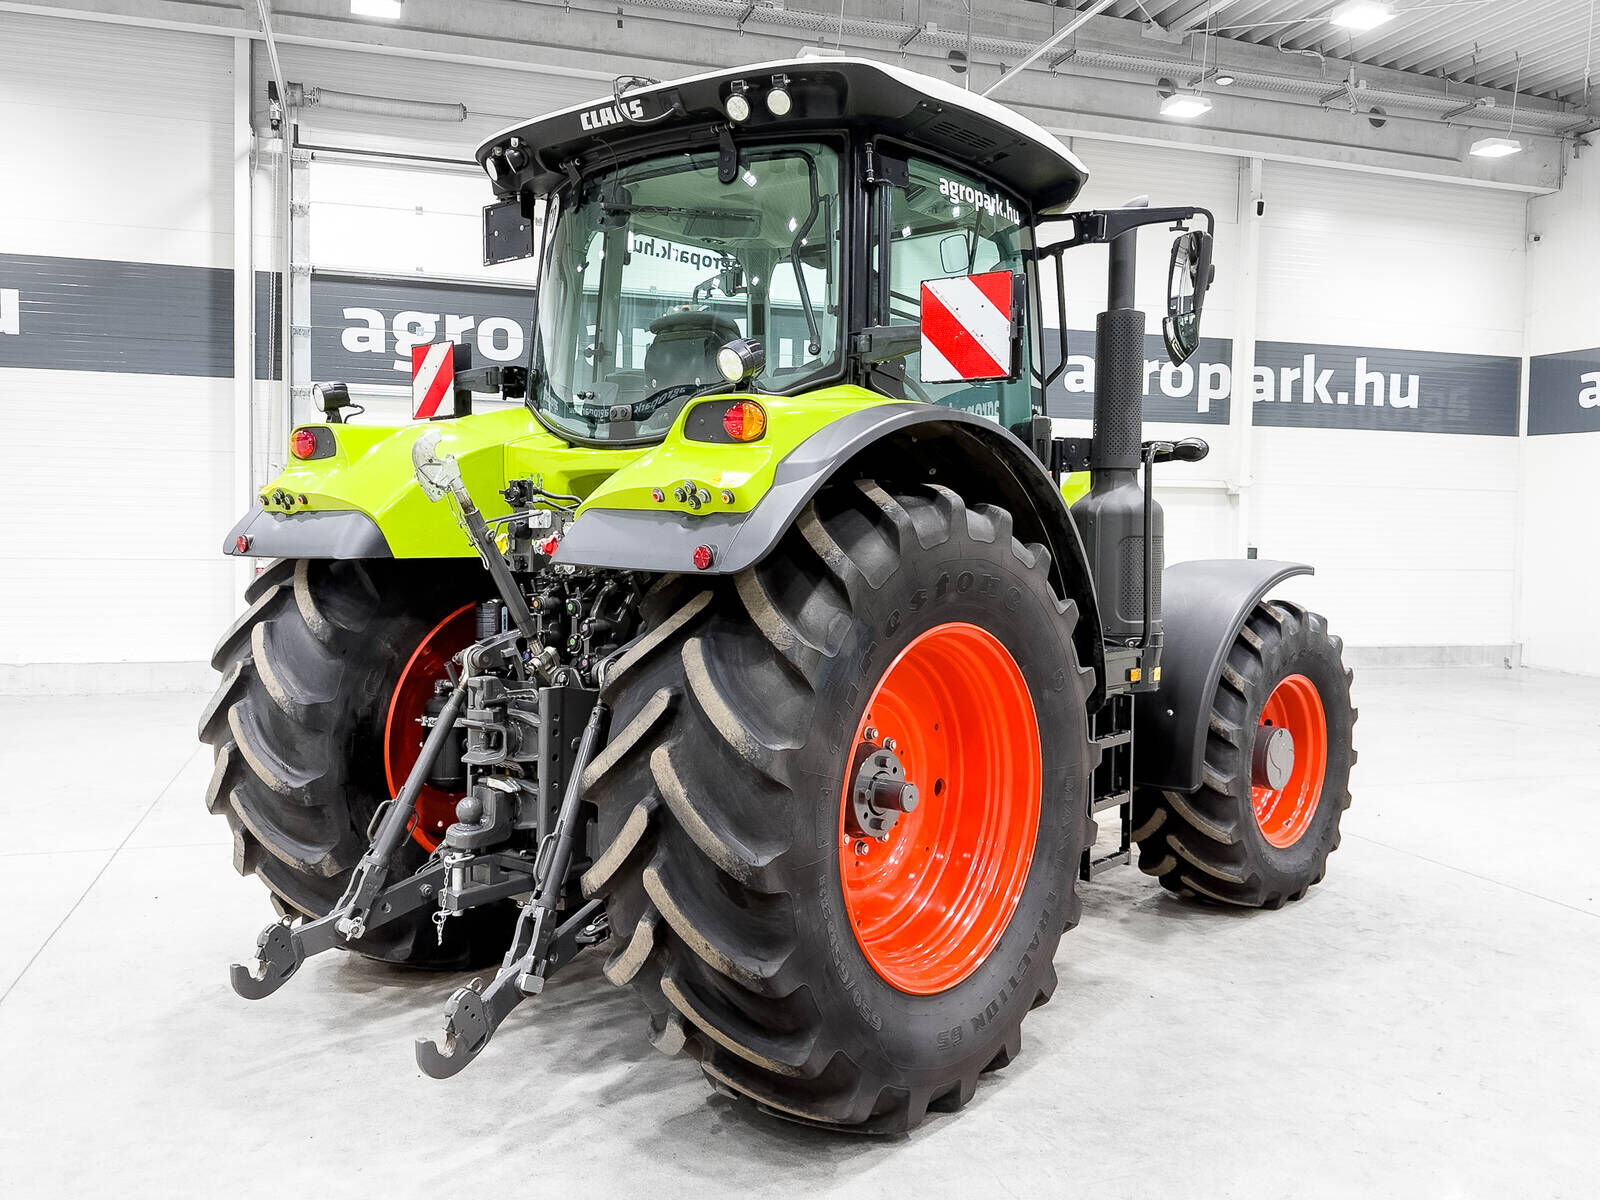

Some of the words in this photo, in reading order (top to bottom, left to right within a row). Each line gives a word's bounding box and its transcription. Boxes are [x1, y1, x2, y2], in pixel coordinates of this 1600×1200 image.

[580, 99, 644, 130] CLAAS
[939, 178, 1020, 225] agropark.hu
[1064, 354, 1420, 413] aropark.hu
